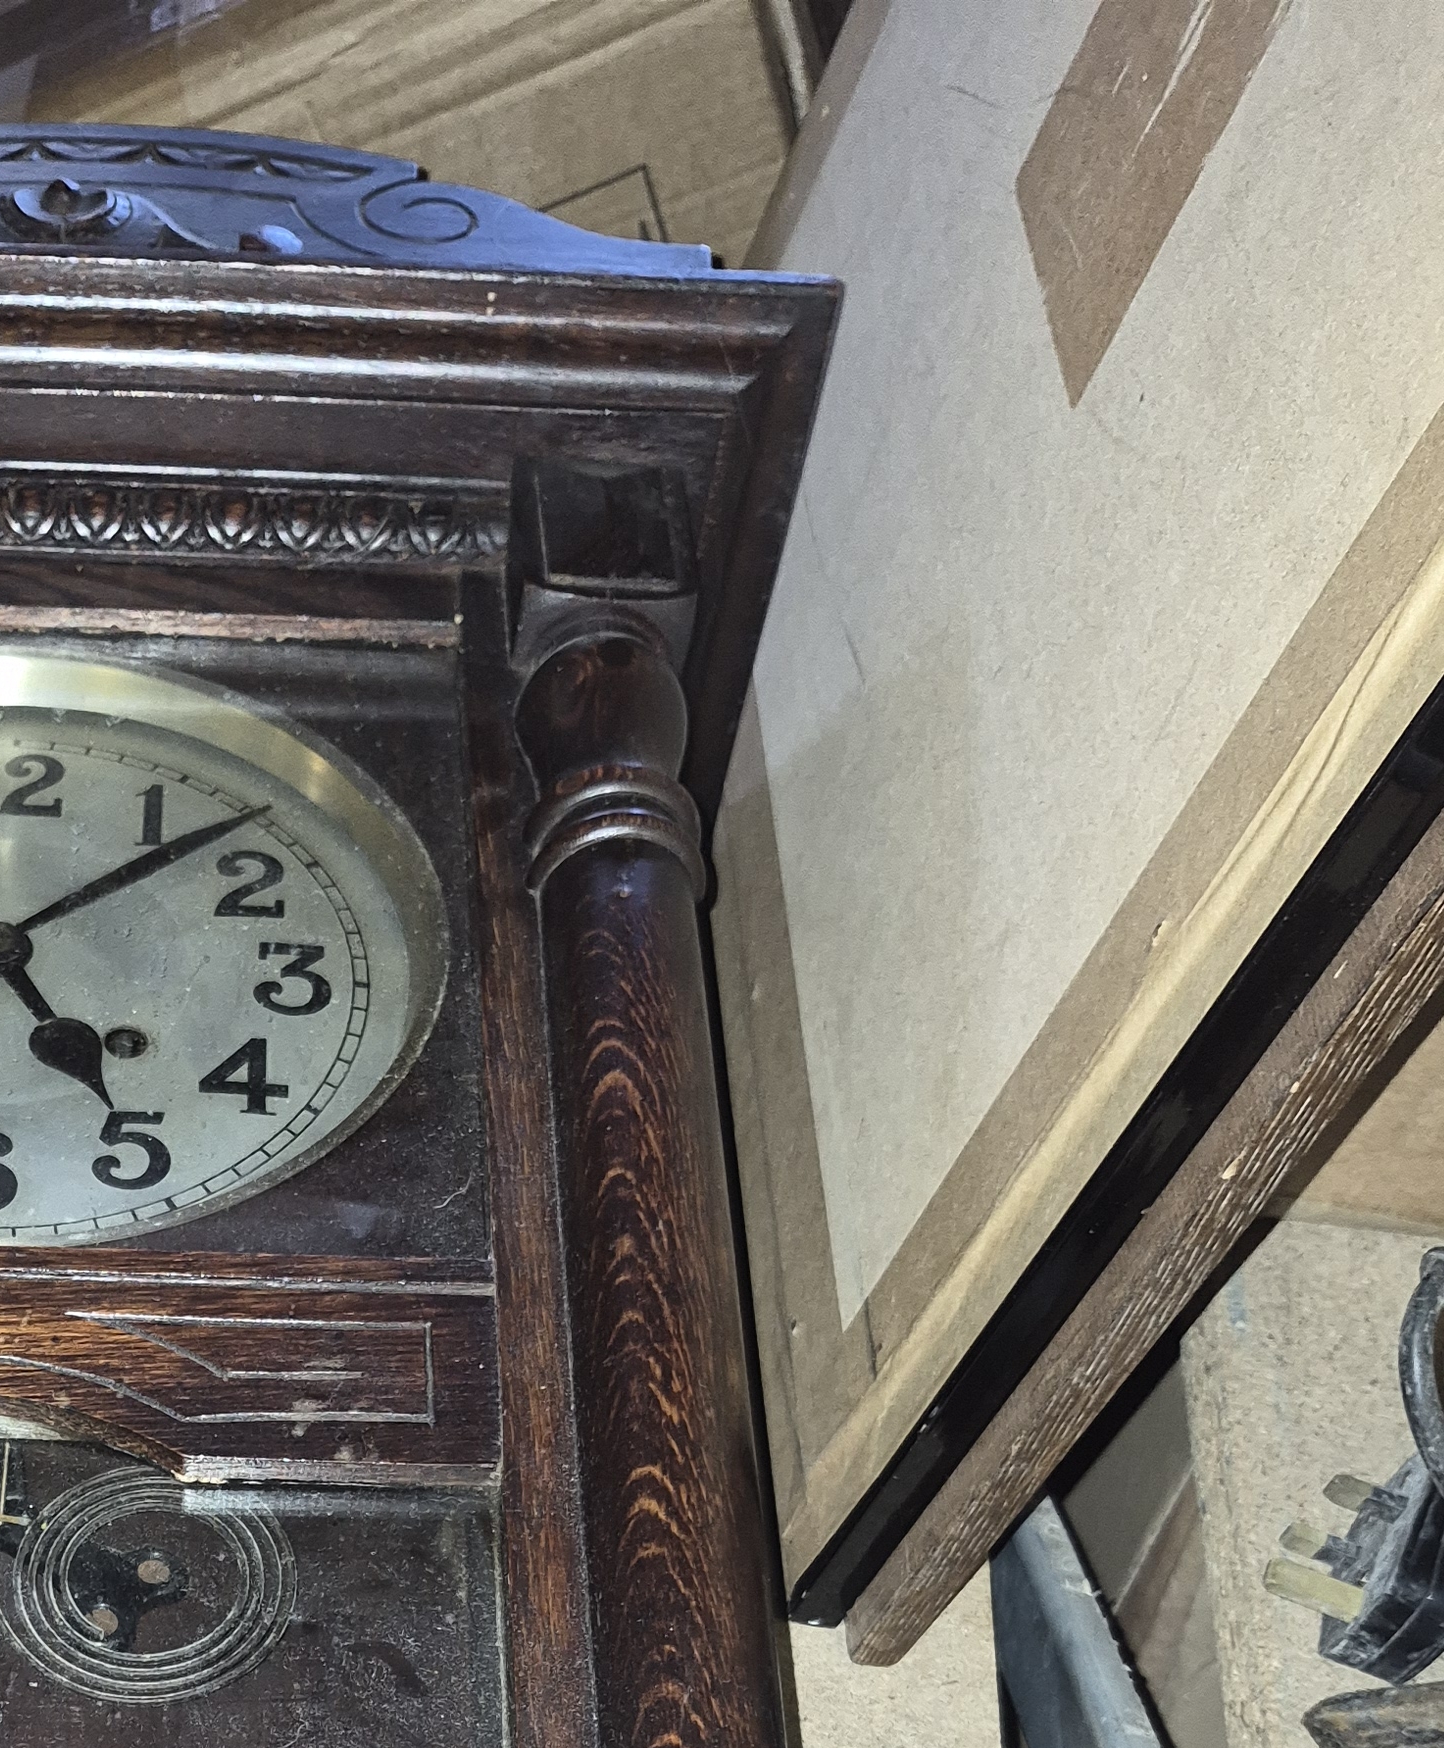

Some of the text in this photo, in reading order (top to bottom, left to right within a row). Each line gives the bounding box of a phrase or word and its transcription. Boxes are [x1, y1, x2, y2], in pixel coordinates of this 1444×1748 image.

[135, 784, 167, 848] 1
[213, 849, 286, 919] 2
[252, 941, 333, 1017] 3
[198, 1037, 289, 1116] 4
[91, 1110, 172, 1191] 5
